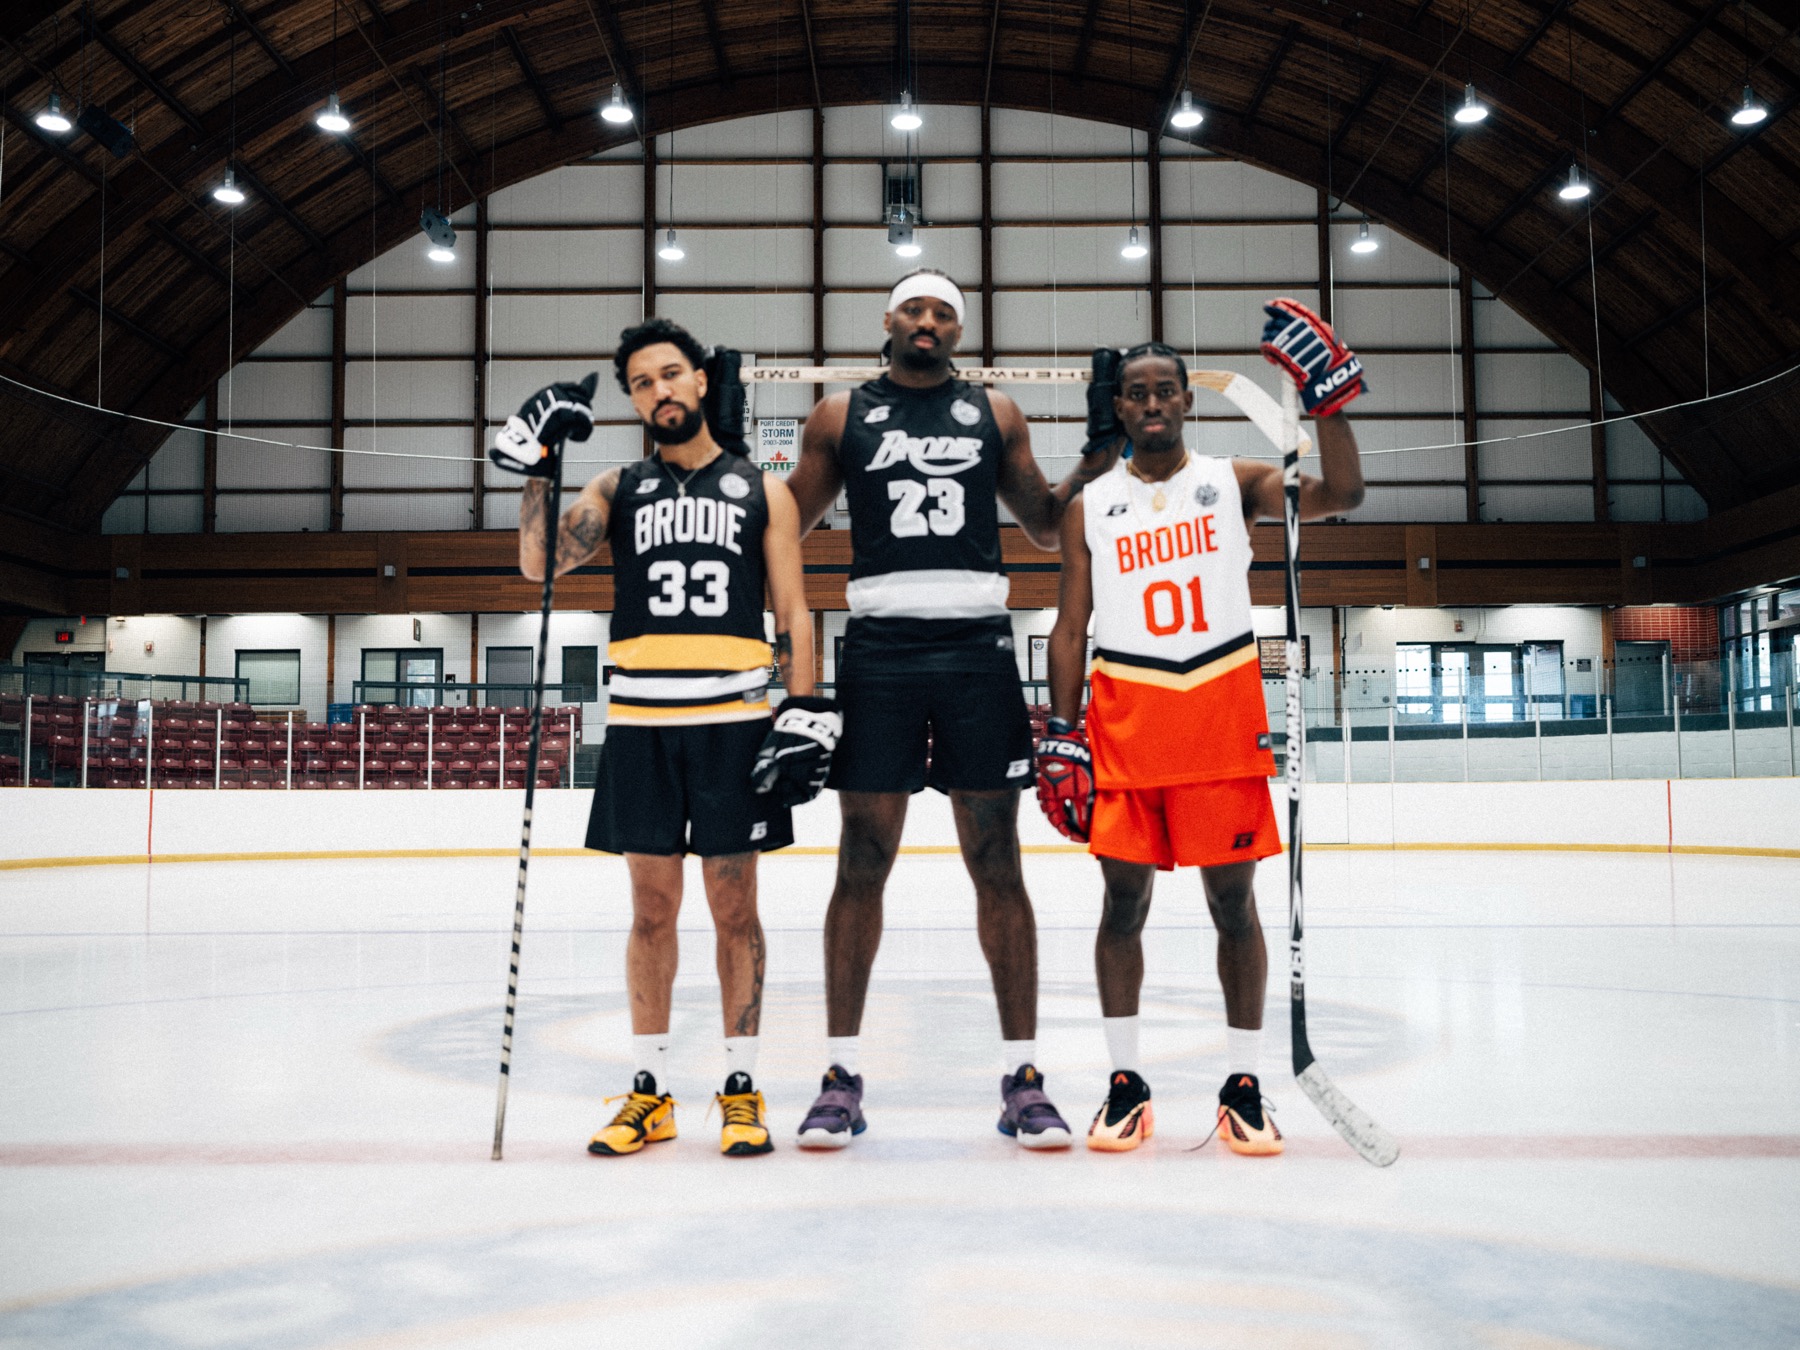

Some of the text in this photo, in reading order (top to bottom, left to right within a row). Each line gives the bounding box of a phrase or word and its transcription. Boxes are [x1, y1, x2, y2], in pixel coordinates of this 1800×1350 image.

[762, 429, 795, 438] STORM
[635, 496, 747, 556] BRODIE
[887, 478, 965, 538] 23
[1115, 514, 1219, 574] BRODIE
[647, 560, 730, 617] 33
[1143, 574, 1209, 637] 01
[1286, 640, 1301, 800] SHERWOOD
